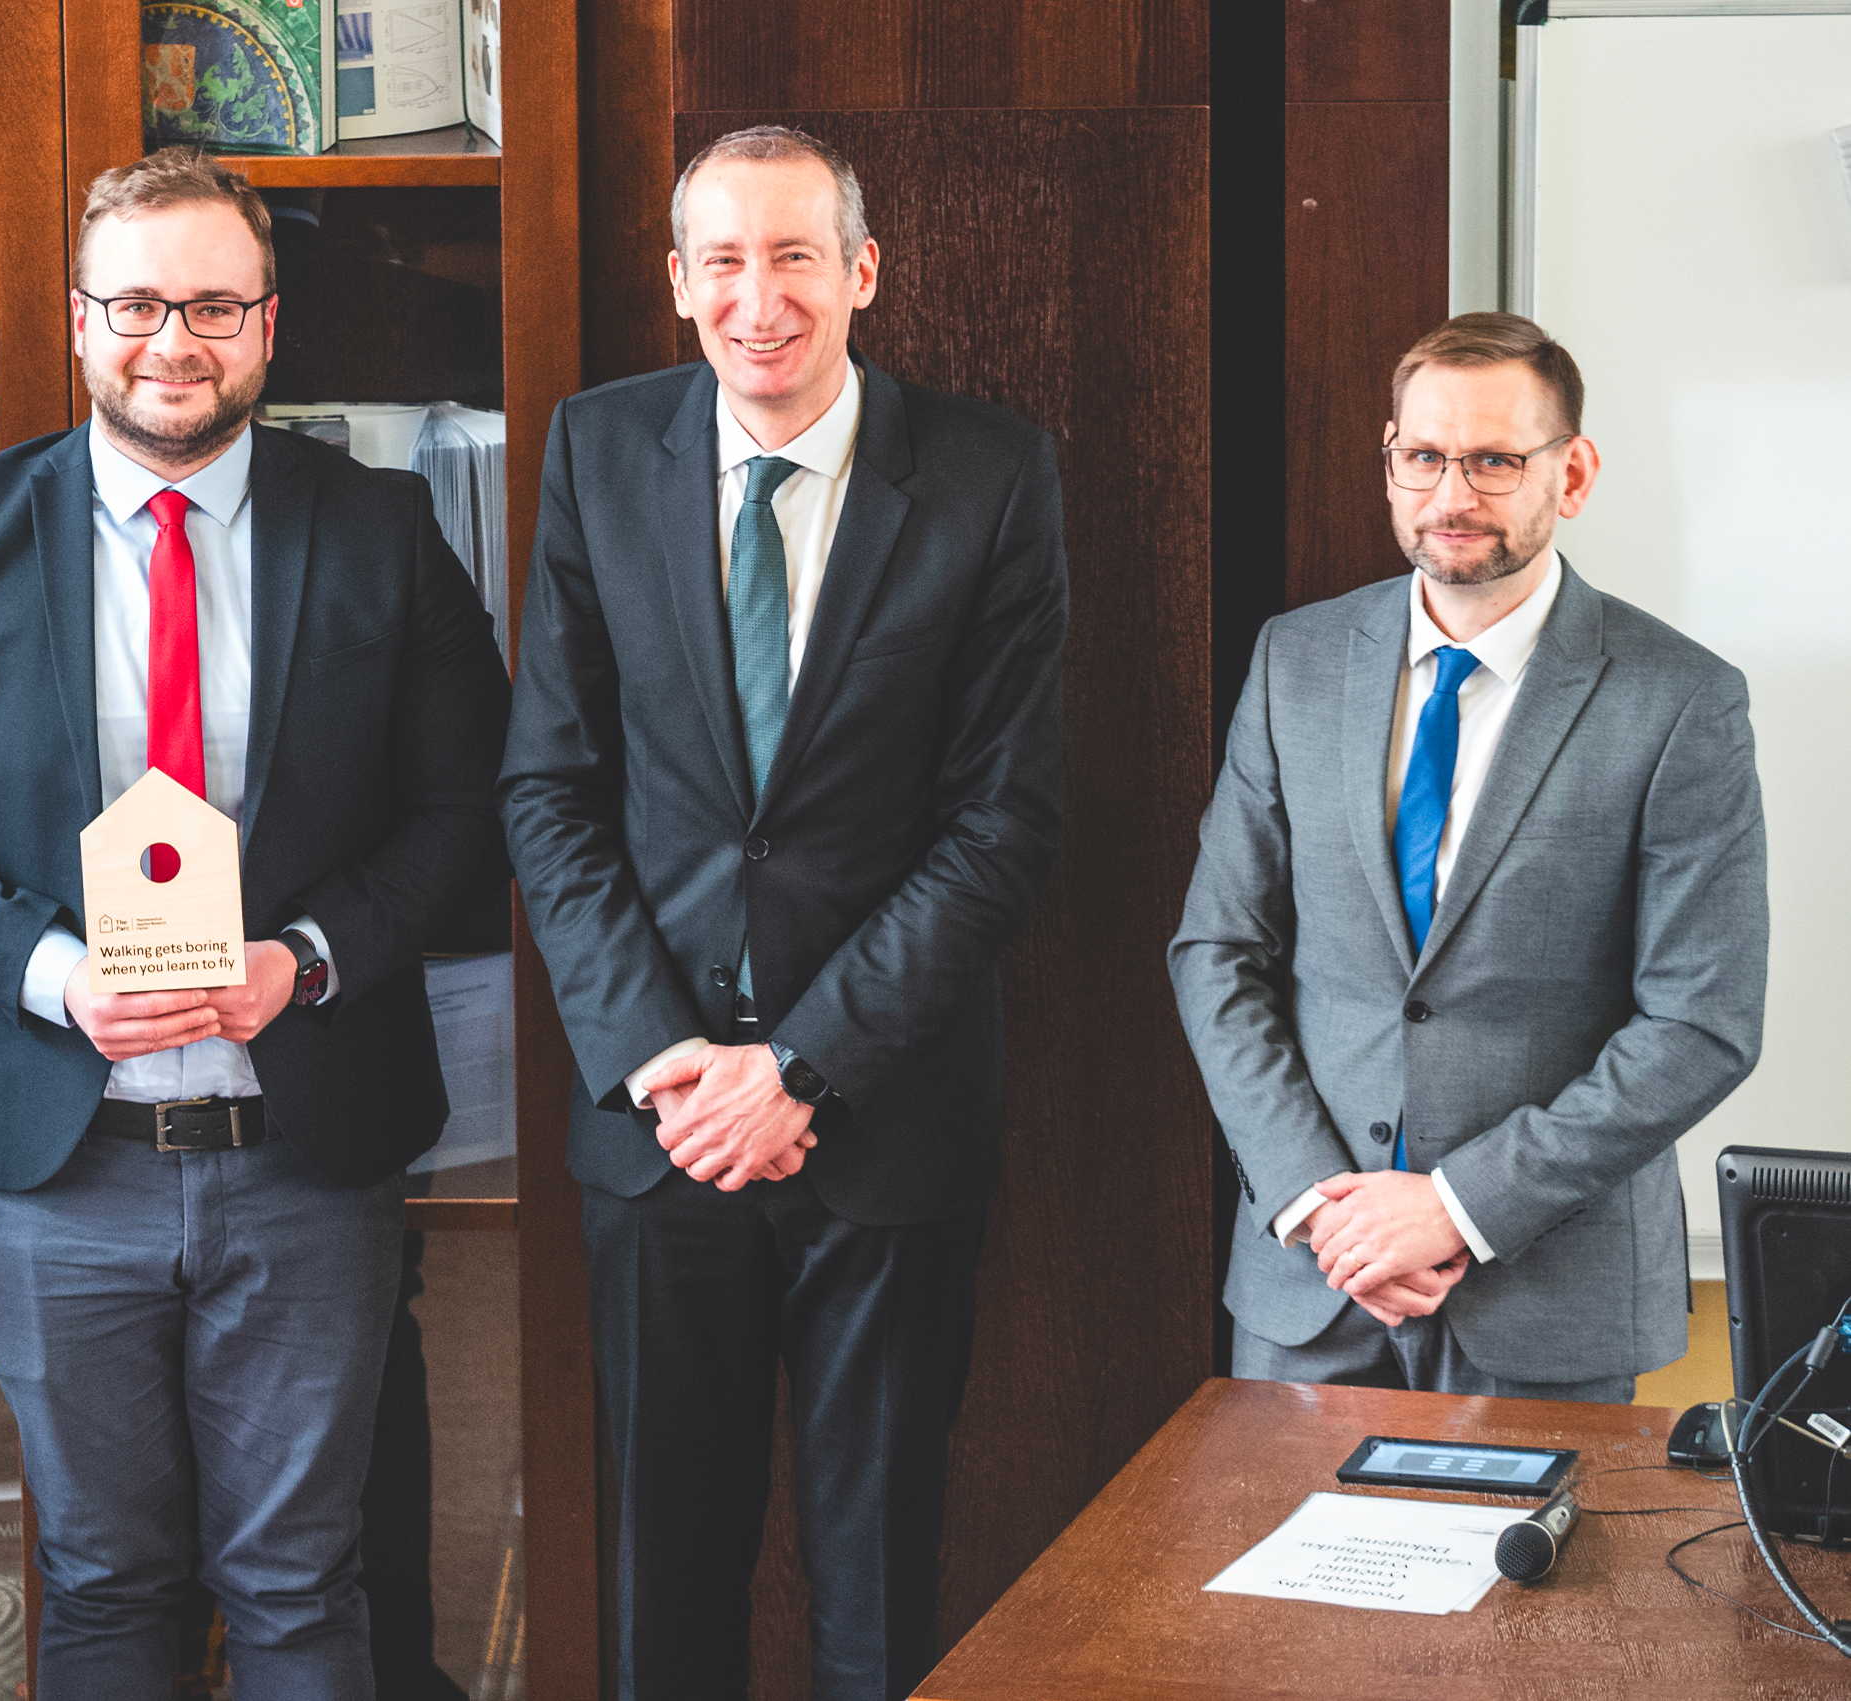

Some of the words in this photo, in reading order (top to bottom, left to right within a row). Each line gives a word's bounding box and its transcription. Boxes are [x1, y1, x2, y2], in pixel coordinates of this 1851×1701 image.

[100, 944, 153, 959] Walking
[155, 943, 183, 959] gets
[185, 940, 228, 954] boring
[100, 963, 137, 976] when
[140, 963, 164, 976] you
[167, 960, 199, 972] learn
[202, 959, 216, 970] to
[219, 956, 235, 971] fly
[1297, 1541, 1472, 1566] vzduchotechniku.
[1344, 1535, 1451, 1554] Děkujeme.
[1306, 1572, 1395, 1588] poslední
[1312, 1563, 1407, 1579] vyučující
[1271, 1578, 1310, 1589] aby
[1318, 1583, 1405, 1601] Prosíme,
